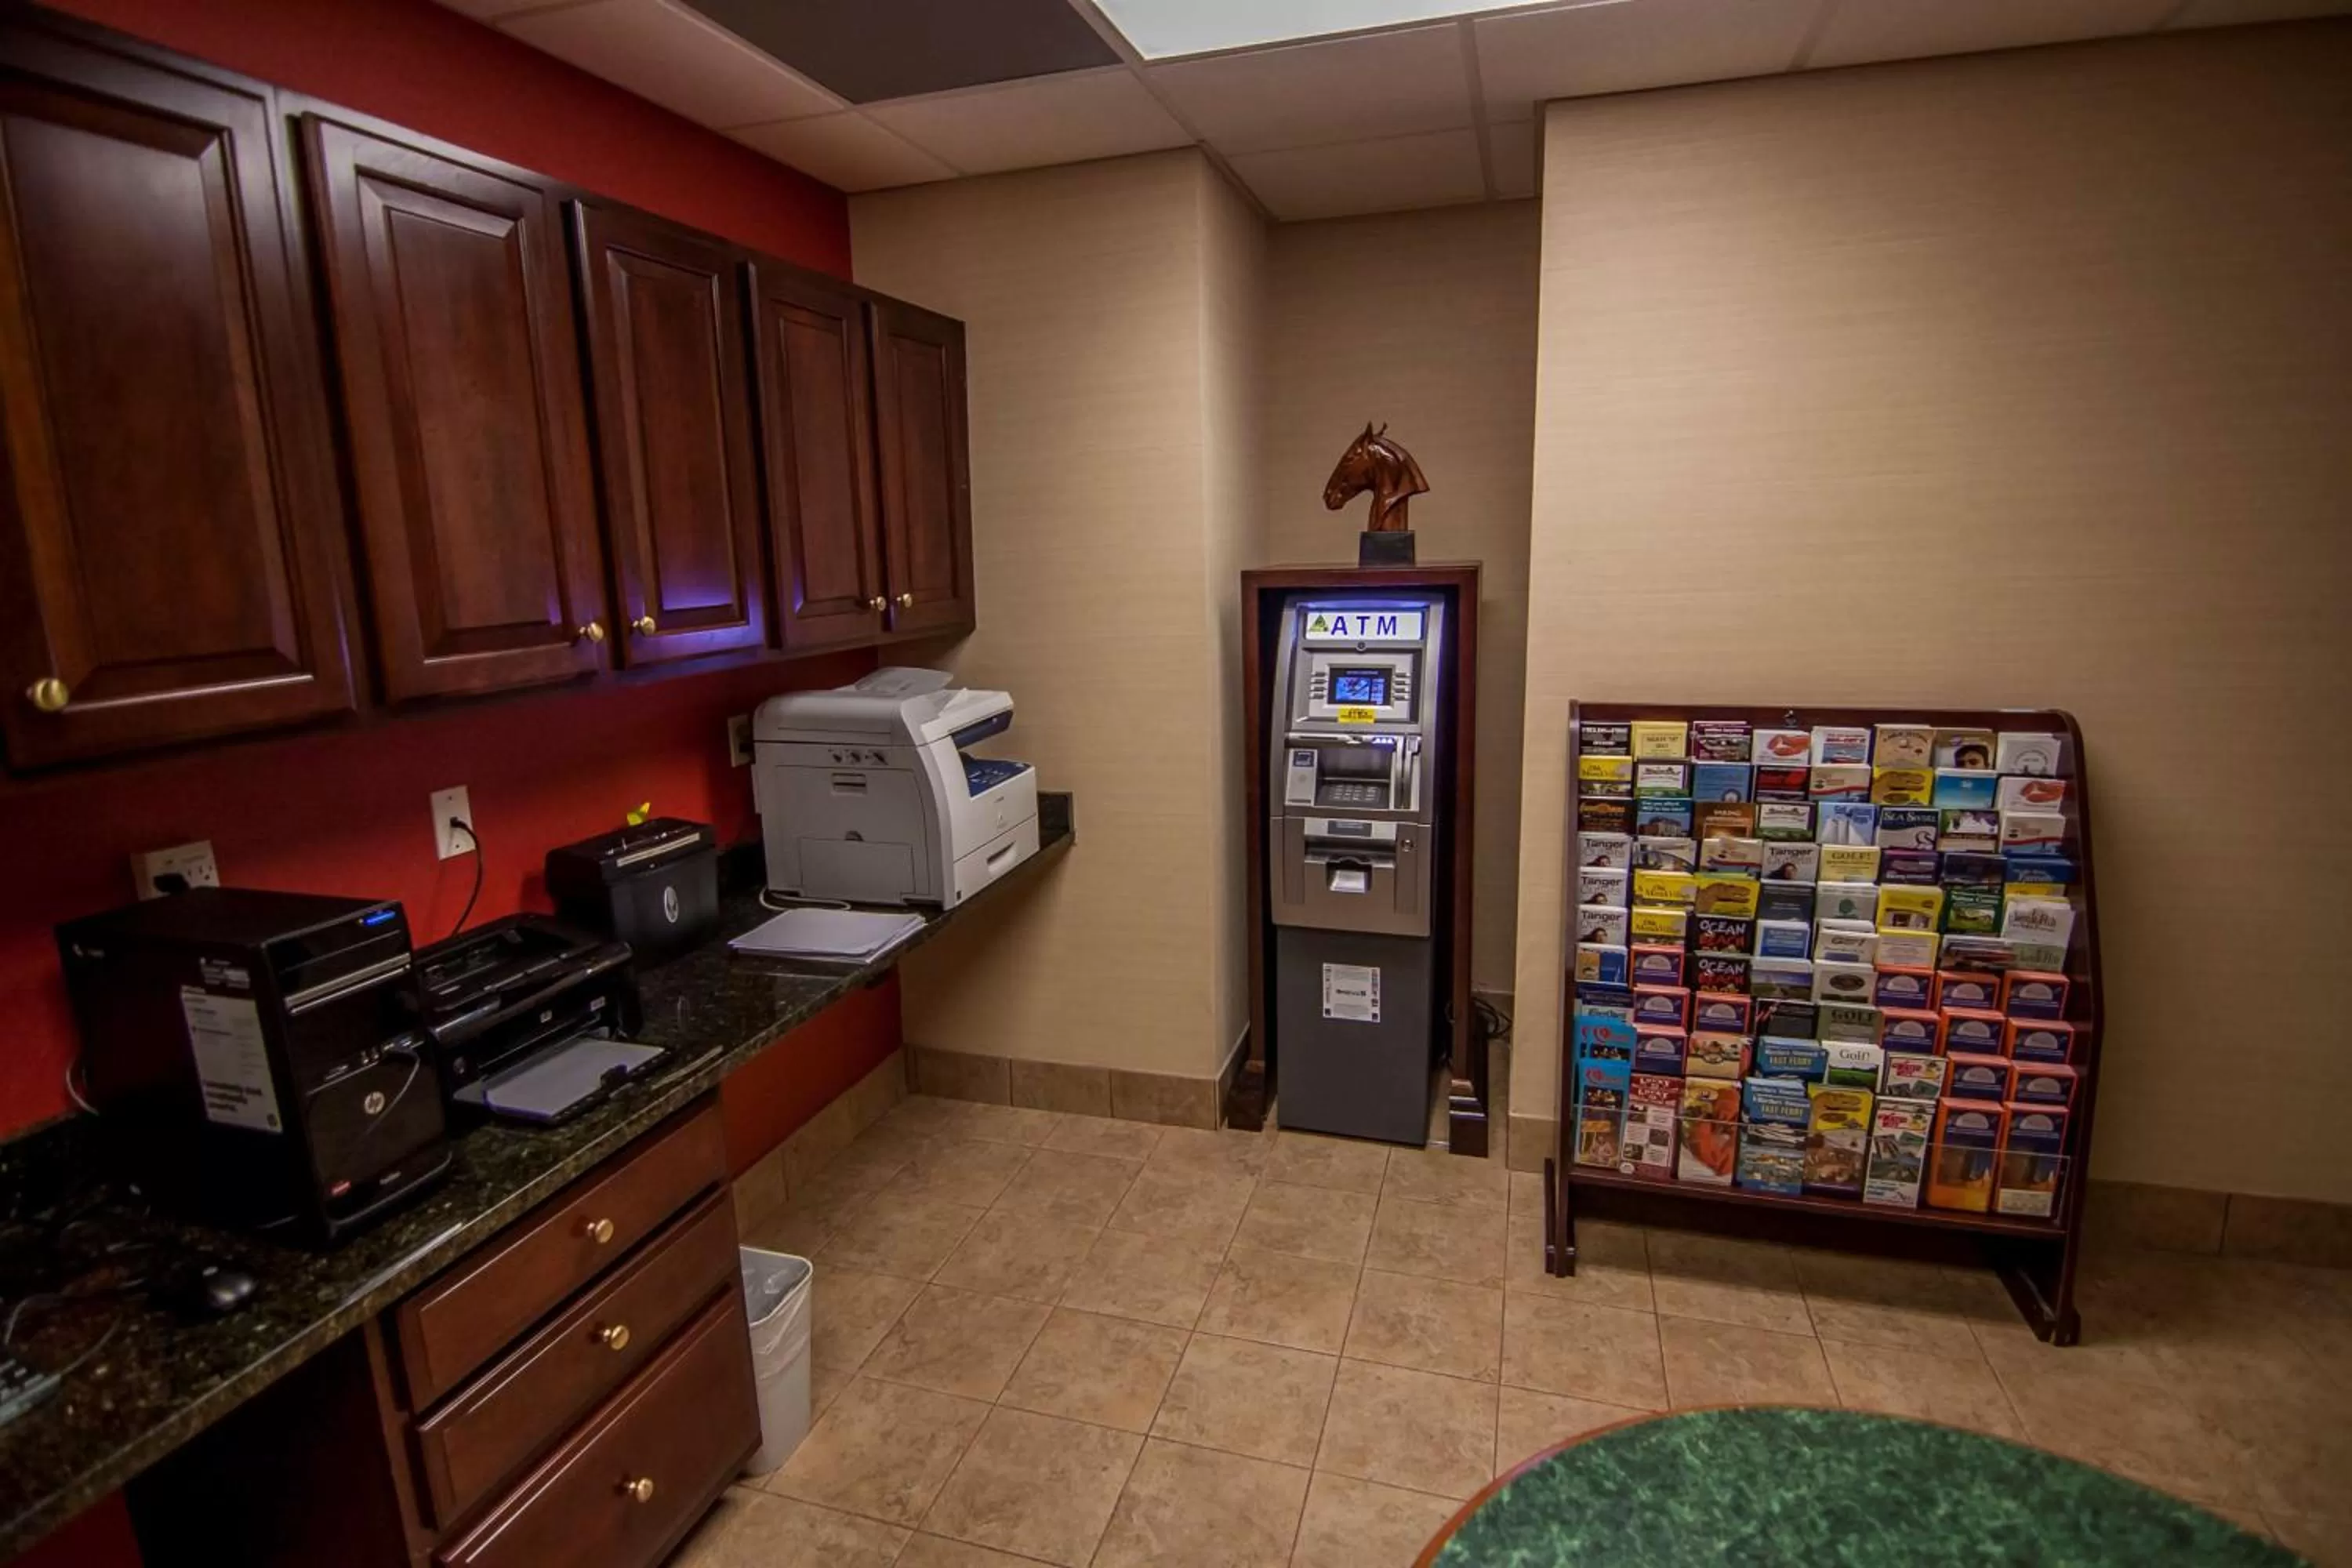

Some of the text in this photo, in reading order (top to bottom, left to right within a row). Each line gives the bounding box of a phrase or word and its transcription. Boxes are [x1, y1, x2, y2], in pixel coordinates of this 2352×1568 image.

[1330, 615, 1398, 636] ATM
[1585, 838, 1626, 849] Tanger
[1769, 847, 1813, 857] Tanger
[1582, 876, 1622, 887] Tanger
[1581, 910, 1622, 921] Tanger
[1699, 919, 1747, 935] OCEAN
[1698, 959, 1744, 975] OCEAN
[1831, 1008, 1875, 1022] GOLF
[1839, 1049, 1871, 1061] Golf!
